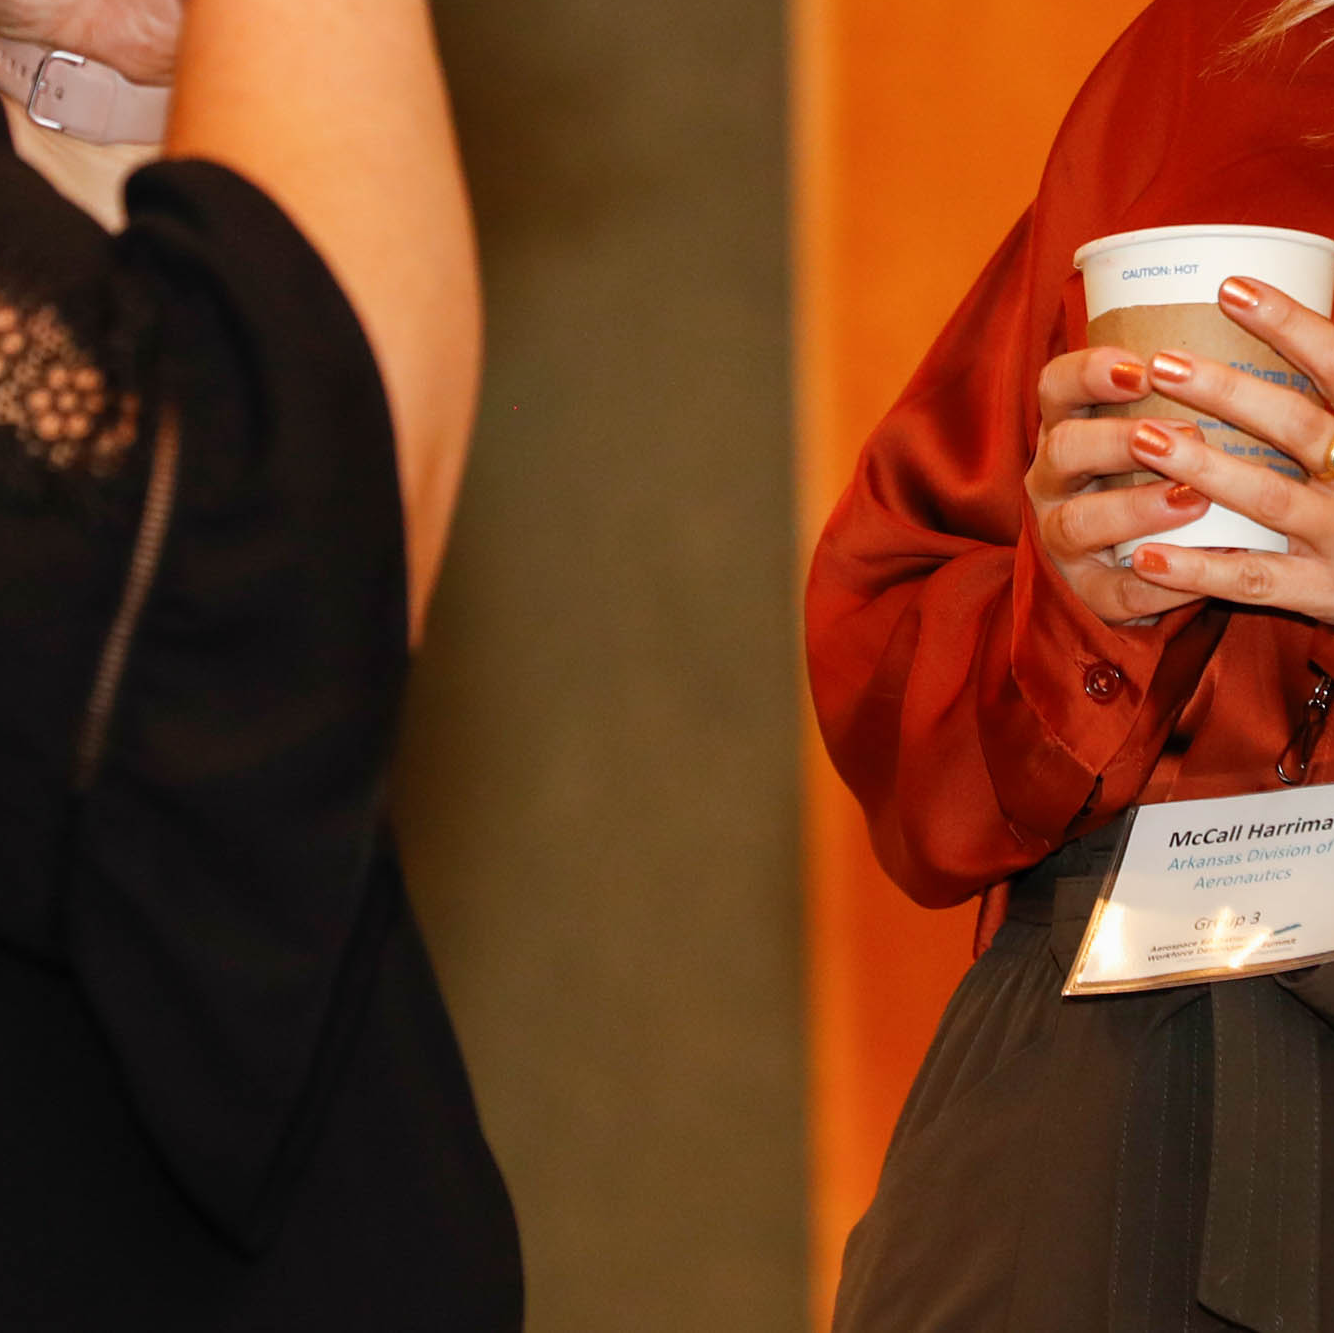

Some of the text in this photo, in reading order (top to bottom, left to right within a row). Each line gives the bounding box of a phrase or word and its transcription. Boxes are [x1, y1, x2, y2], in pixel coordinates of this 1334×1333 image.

[1122, 264, 1199, 280] CAUTION: HOT
[1169, 825, 1243, 848] McCall
[1167, 852, 1243, 872] Arkansas
[1247, 841, 1311, 863] Division
[1193, 867, 1292, 891] Aeronautics
[1194, 911, 1262, 931] Grp 3
